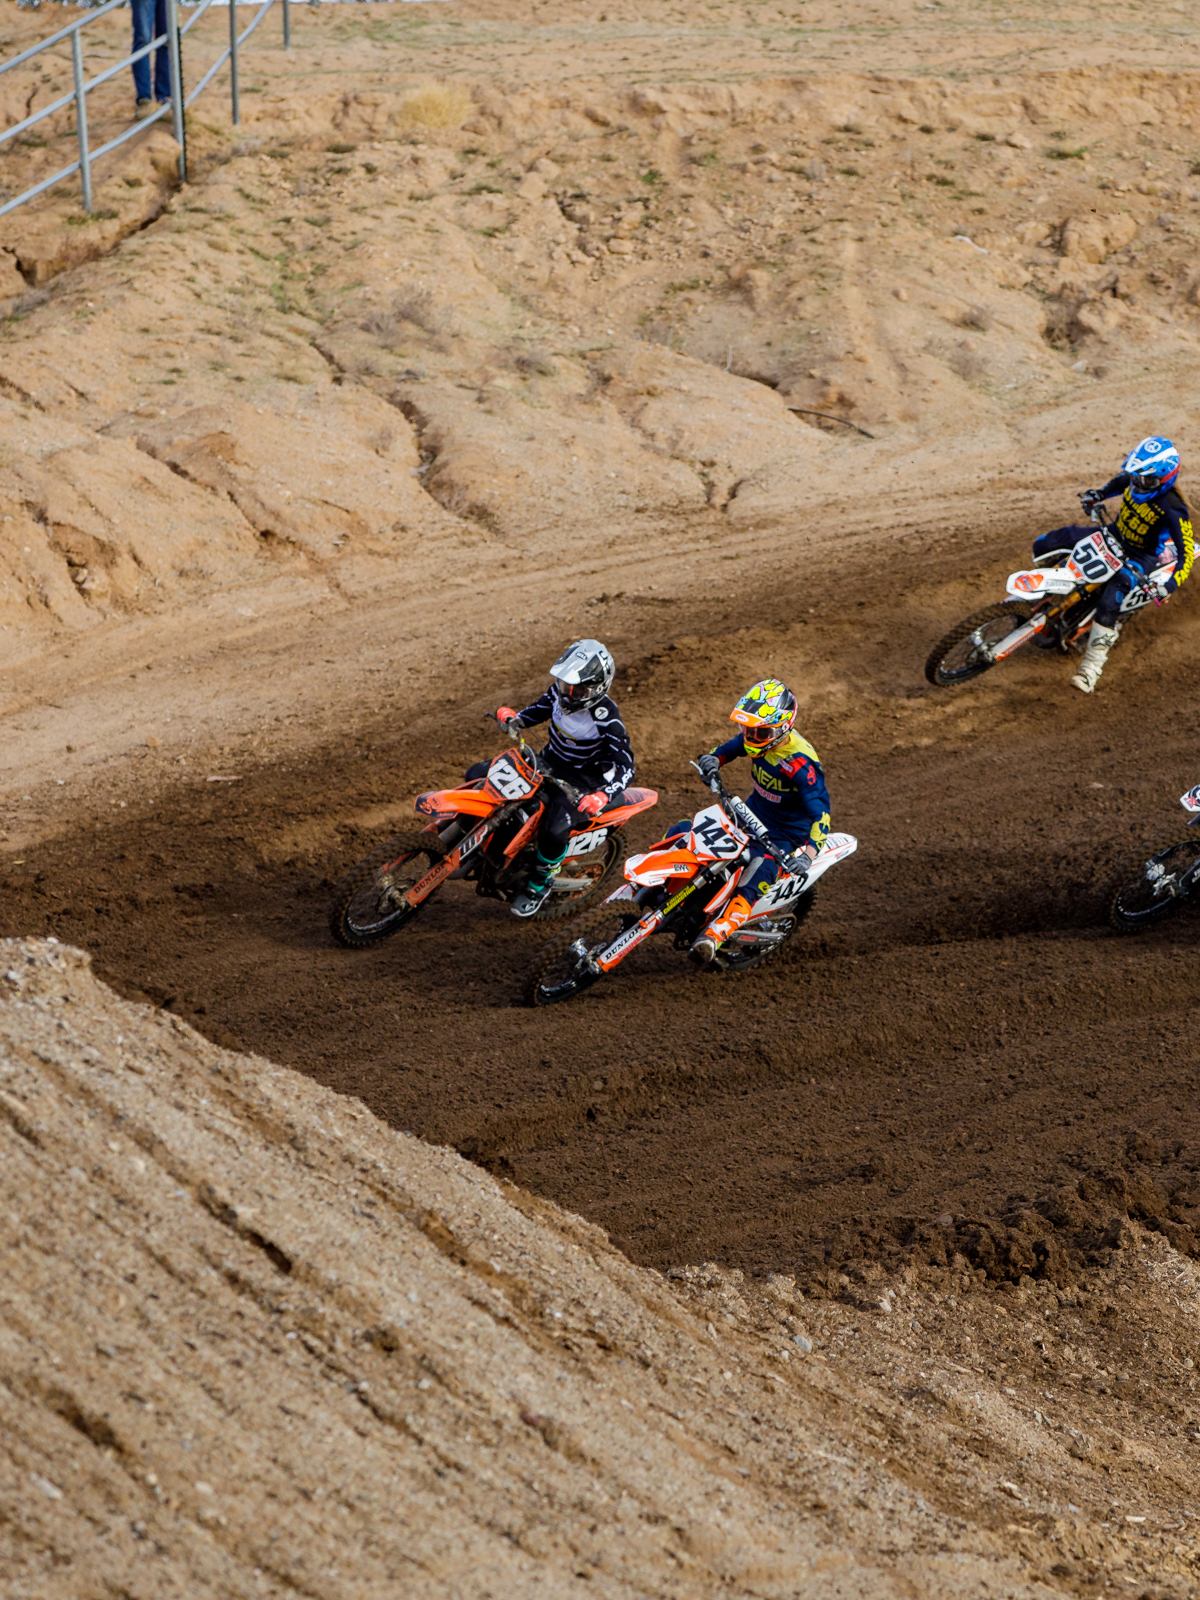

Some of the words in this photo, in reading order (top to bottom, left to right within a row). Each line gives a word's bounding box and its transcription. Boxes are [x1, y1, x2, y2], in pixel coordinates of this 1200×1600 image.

[1073, 542, 1108, 580] 50
[487, 758, 532, 800] 126
[565, 827, 608, 857] 126
[691, 815, 739, 859] 142
[413, 861, 448, 895] DUNLOP
[769, 872, 809, 905] 142
[604, 927, 640, 961] DUNLOP
